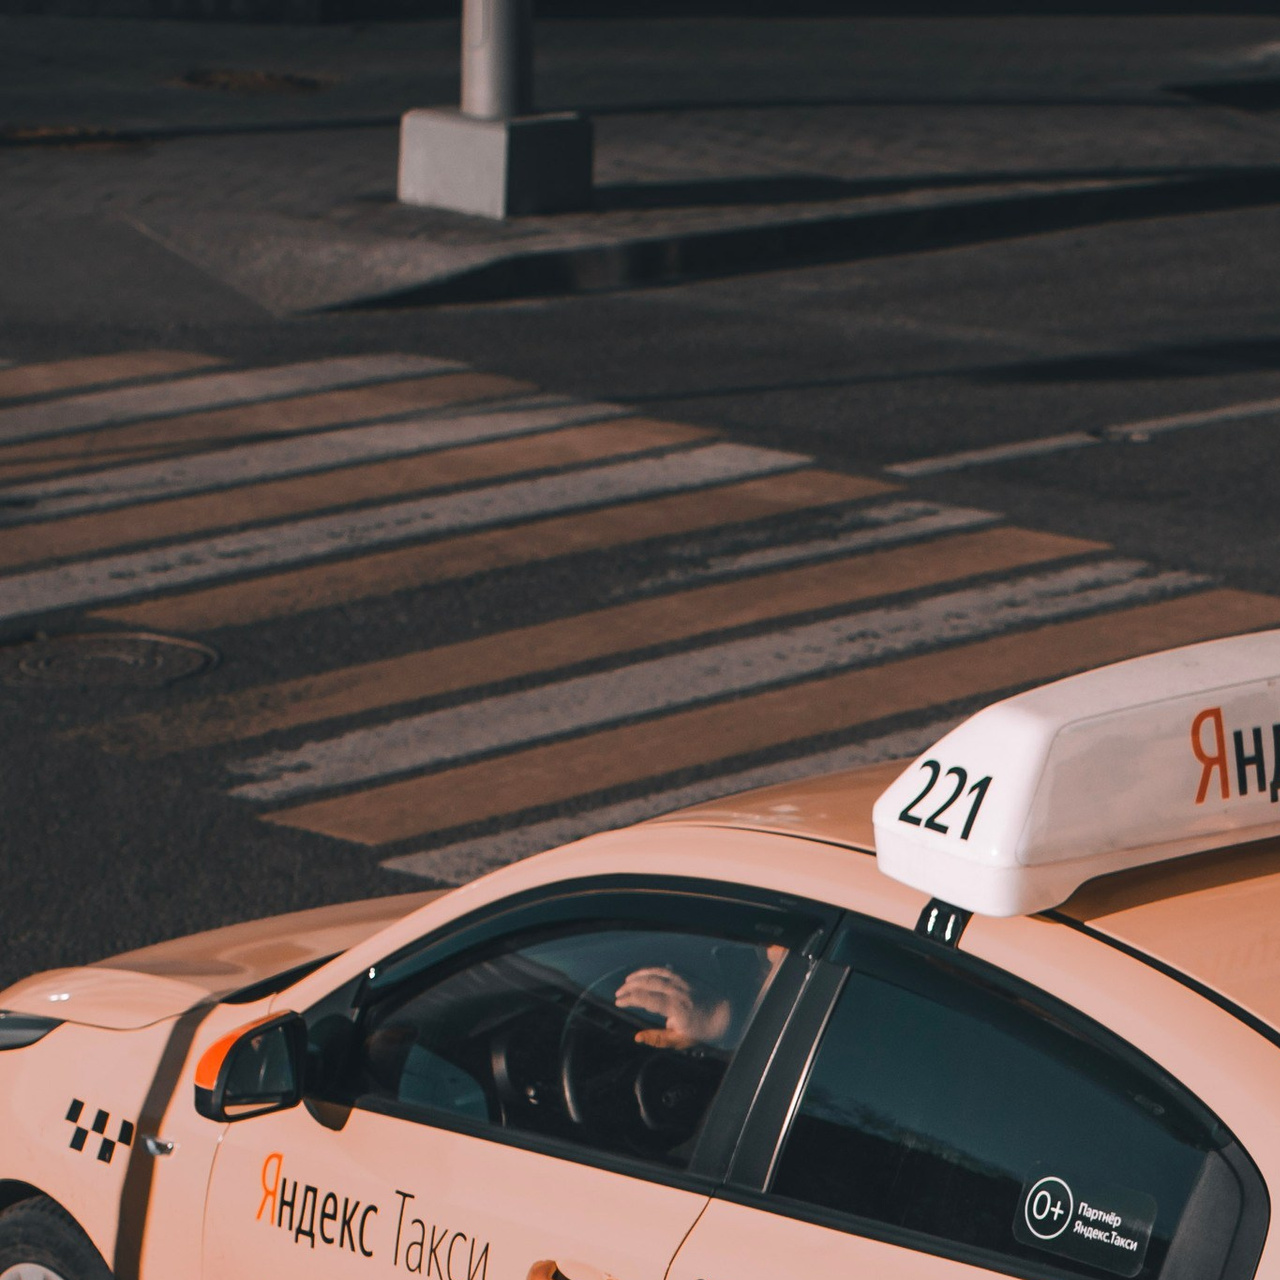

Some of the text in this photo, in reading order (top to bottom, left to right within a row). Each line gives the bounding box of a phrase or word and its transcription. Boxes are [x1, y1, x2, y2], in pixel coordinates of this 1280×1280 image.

[898, 759, 993, 841] 221
[256, 1152, 379, 1258] Яндекс
[1033, 1190, 1064, 1221] 0+
[1078, 1202, 1122, 1228] Партнёр
[1073, 1220, 1138, 1251] Яндекс.Такси
